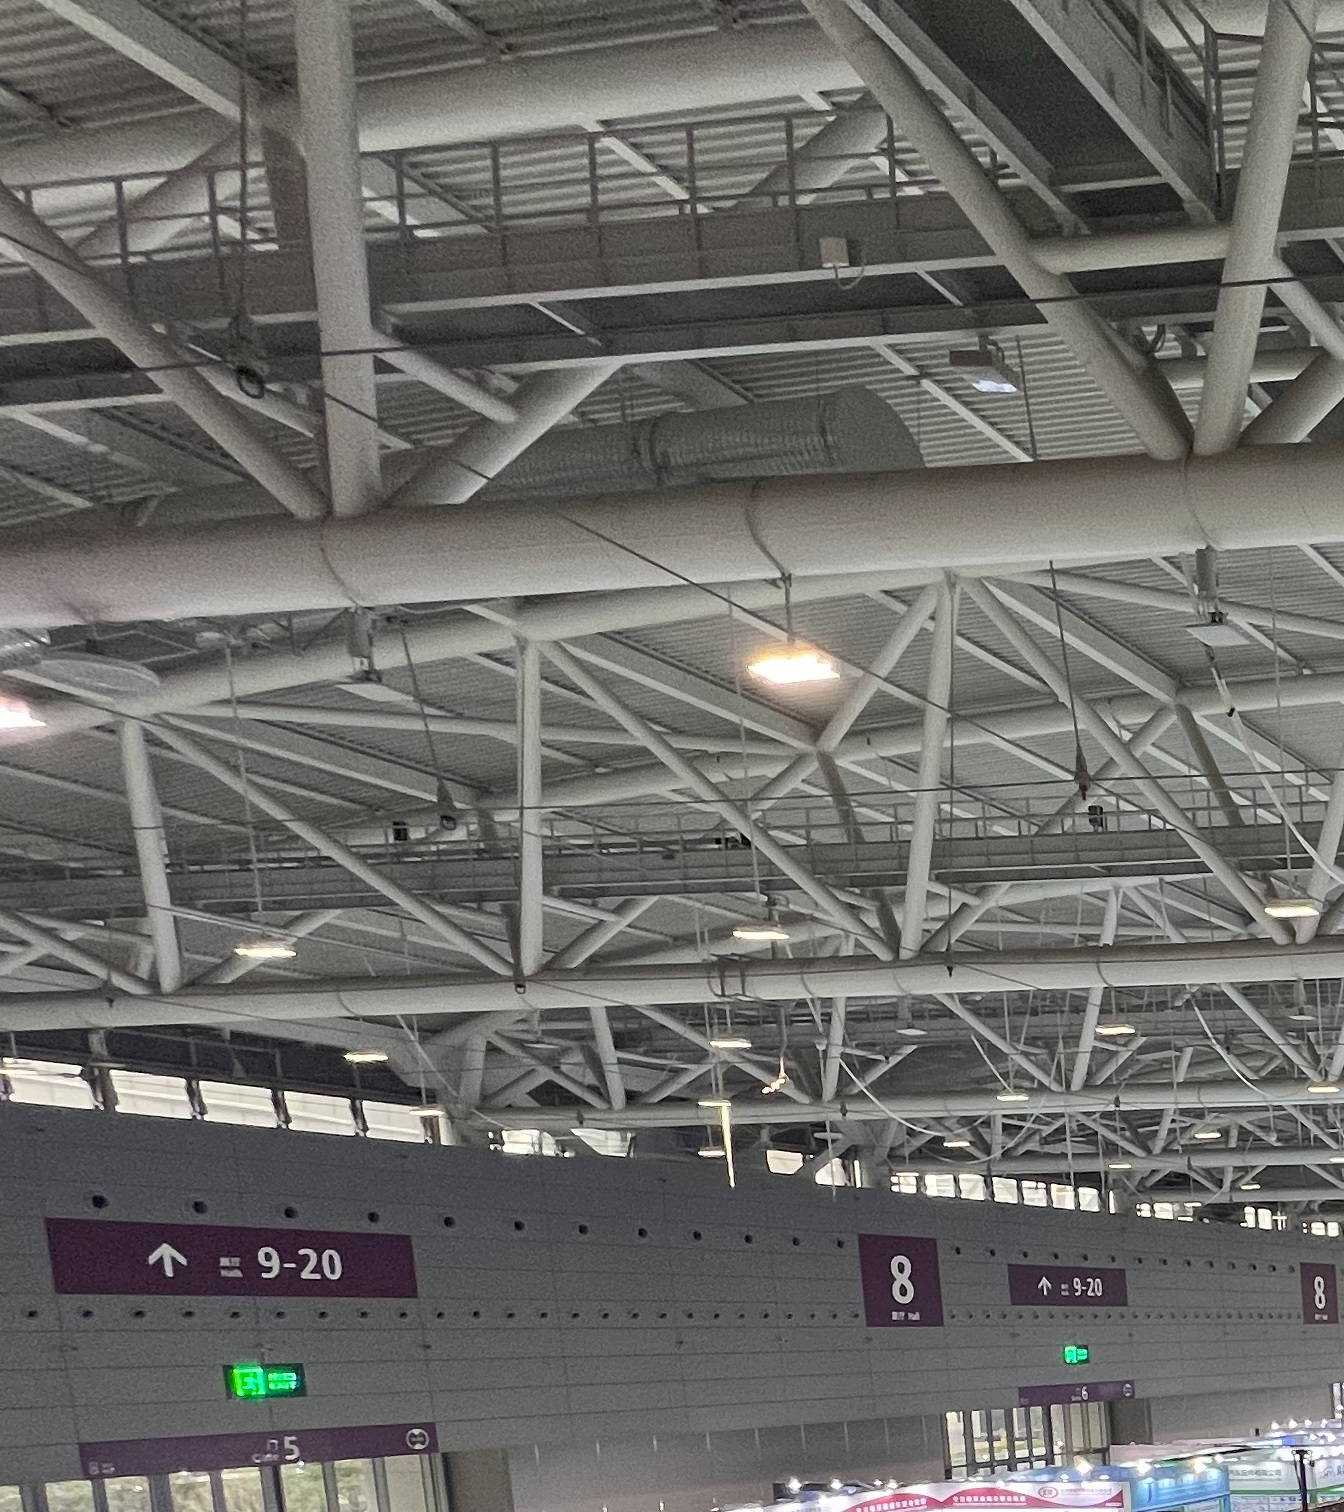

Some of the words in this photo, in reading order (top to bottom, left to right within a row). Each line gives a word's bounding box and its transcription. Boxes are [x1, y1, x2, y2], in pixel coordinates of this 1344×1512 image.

[256, 1246, 343, 1280] 9-20
[890, 1254, 915, 1304] 8
[1072, 1277, 1103, 1298] 9-20
[1314, 1275, 1327, 1310] 8
[283, 1436, 300, 1461] 5
